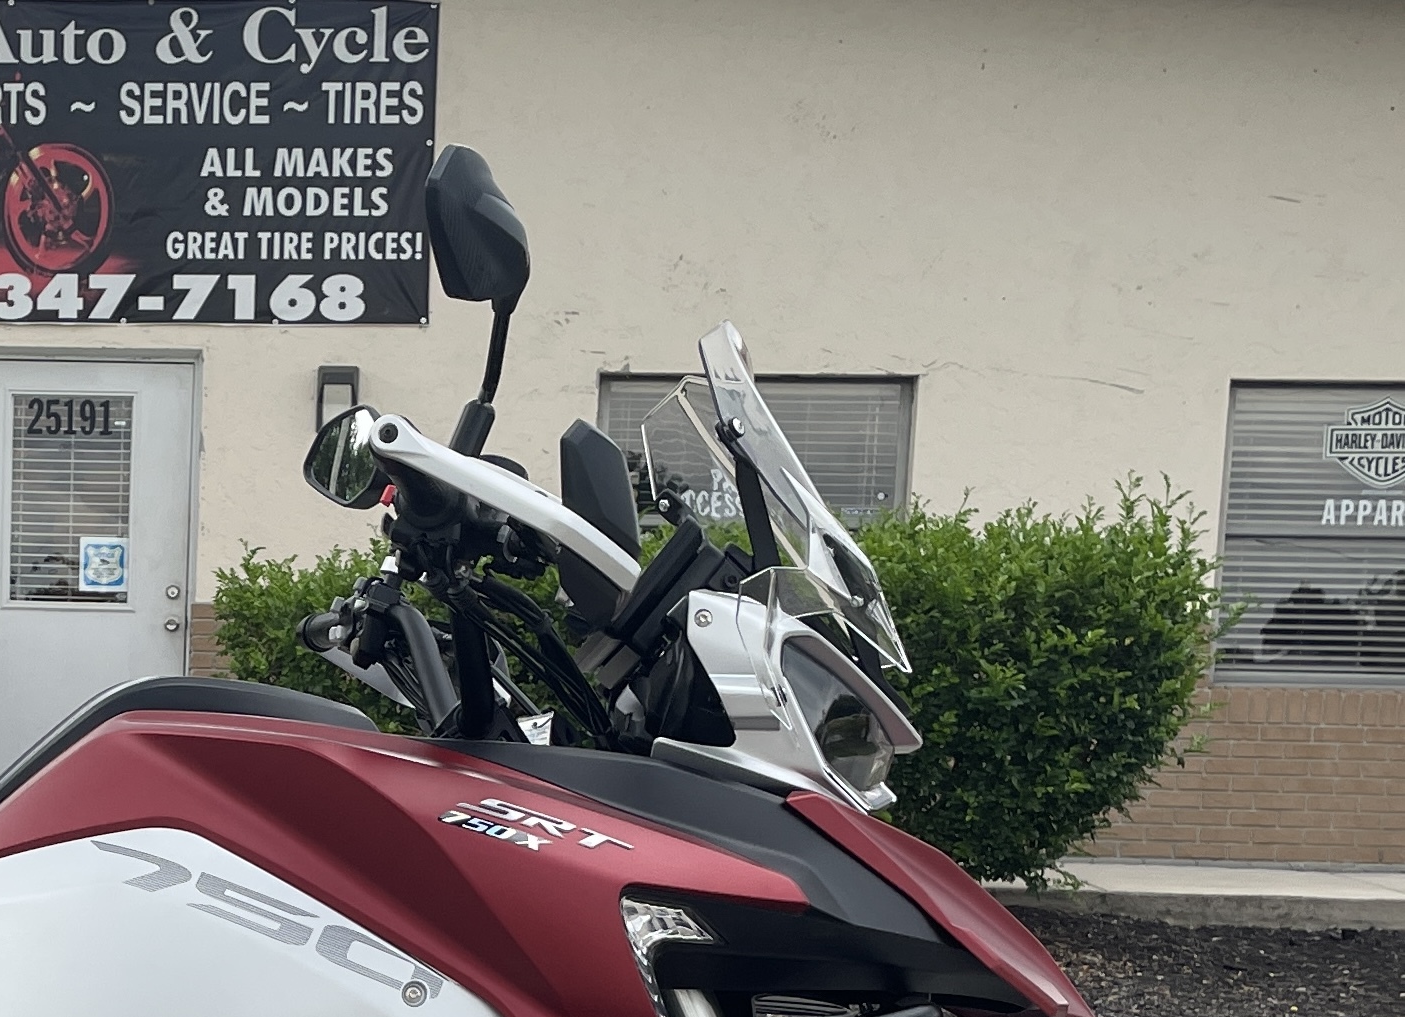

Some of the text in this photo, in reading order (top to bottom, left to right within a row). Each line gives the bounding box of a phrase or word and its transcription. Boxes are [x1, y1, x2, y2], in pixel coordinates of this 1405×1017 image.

[155, 7, 214, 65] &
[242, 5, 430, 74] Cycle
[118, 81, 271, 125] SERVICE
[321, 80, 425, 125] TIRES
[199, 147, 394, 178] ALL MAKES
[203, 186, 389, 217] & MODELS
[165, 231, 423, 261] GREAT TIRE PRICES!
[26, 398, 113, 435] 25191
[1360, 407, 1405, 426] MOTO
[456, 798, 635, 851] SRT
[90, 839, 443, 1000] 750
